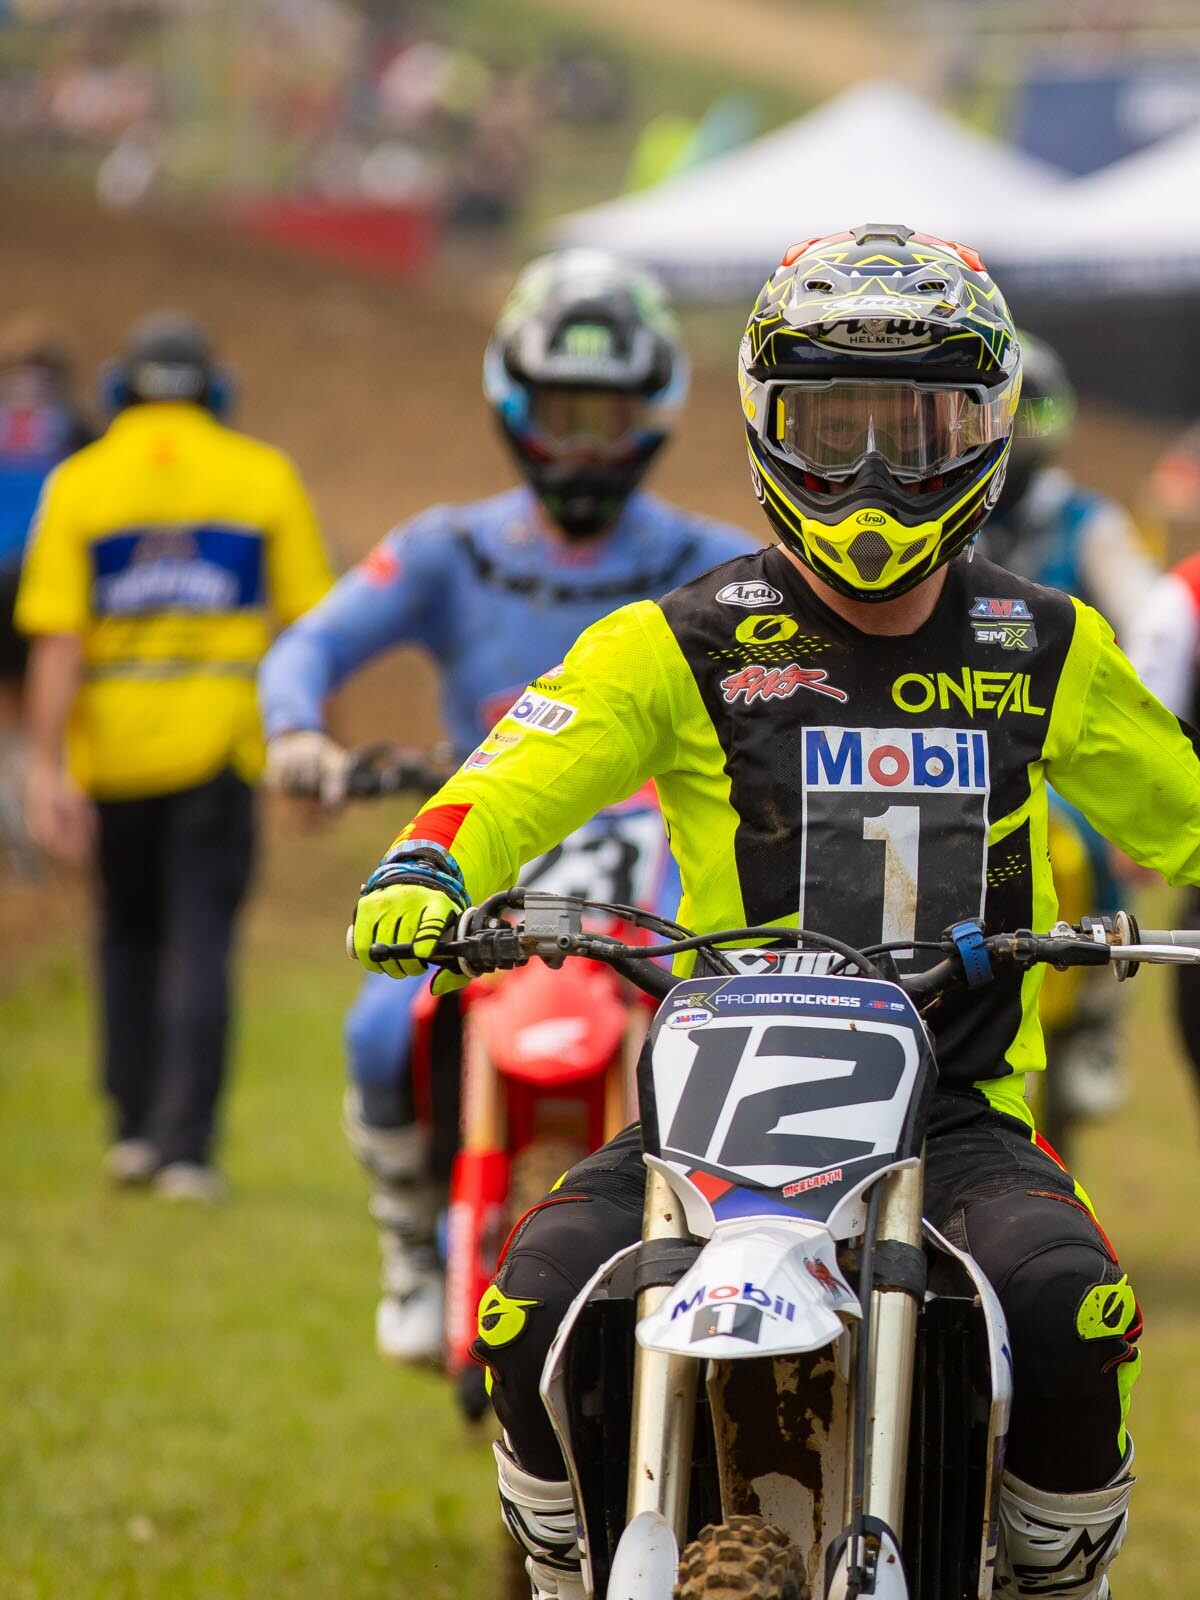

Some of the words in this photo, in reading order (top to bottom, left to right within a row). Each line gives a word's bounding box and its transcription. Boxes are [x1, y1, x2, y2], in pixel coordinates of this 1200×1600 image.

[859, 512, 884, 523] Arai
[722, 586, 773, 600] Arai
[972, 599, 1029, 616] AMA
[976, 627, 1029, 649] SMX
[892, 667, 1046, 719] O'NEAL
[547, 709, 565, 728] 1
[805, 730, 985, 788] Mobil
[862, 805, 921, 959] 1
[666, 1026, 906, 1167] 12
[671, 1282, 795, 1322] Mobil
[712, 1303, 736, 1334] 1
